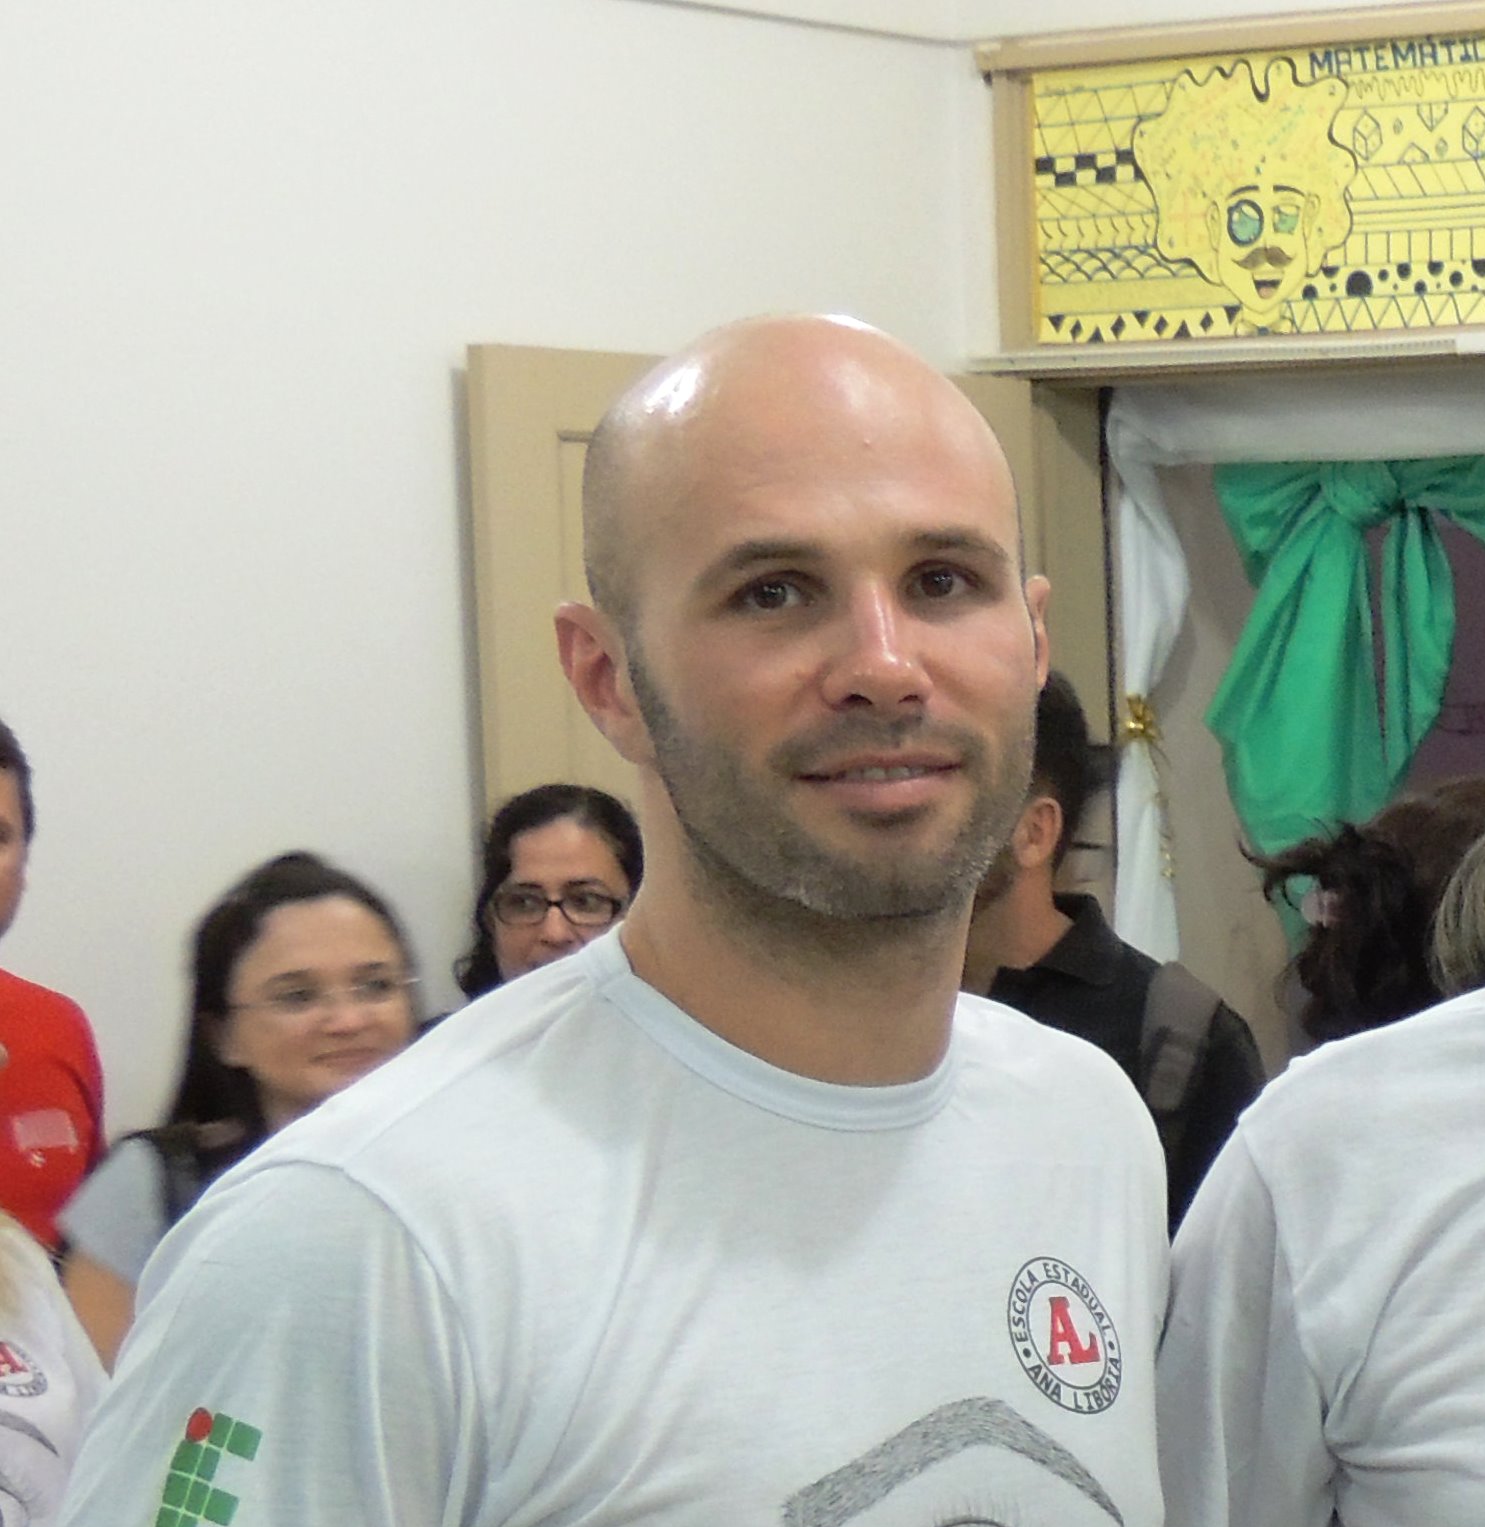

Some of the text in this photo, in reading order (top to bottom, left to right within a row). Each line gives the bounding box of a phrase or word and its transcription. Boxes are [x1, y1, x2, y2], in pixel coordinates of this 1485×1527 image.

[1012, 1262, 1112, 1343] ESCOLA ESTADUAL
[1027, 1363, 1063, 1402] ANA
